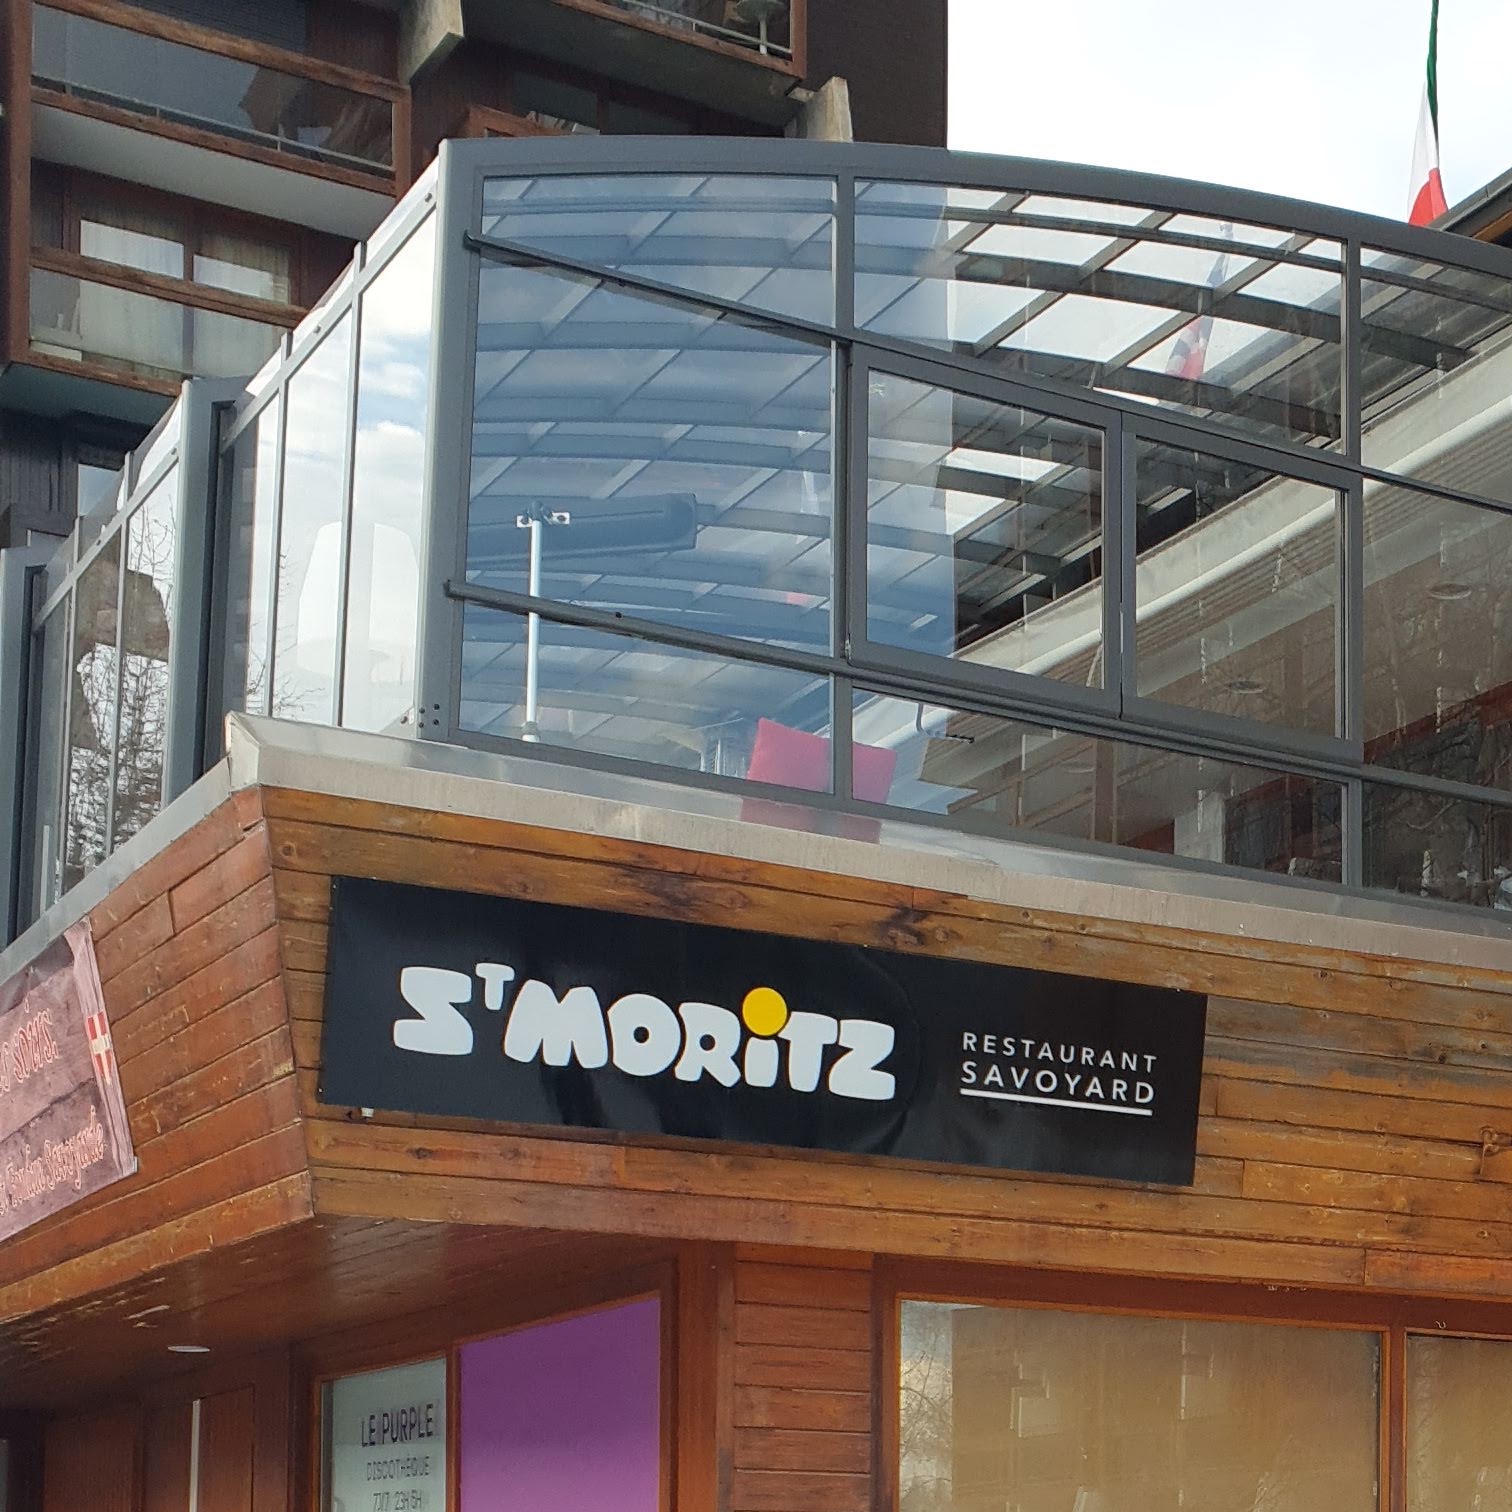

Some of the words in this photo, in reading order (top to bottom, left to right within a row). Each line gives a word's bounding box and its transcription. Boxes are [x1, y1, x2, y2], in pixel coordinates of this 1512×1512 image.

[962, 1031, 1158, 1074] RESTAURANT
[960, 1060, 1156, 1106] SAVOYARD
[361, 1414, 376, 1448] LE
[382, 1403, 433, 1445] PURPLE
